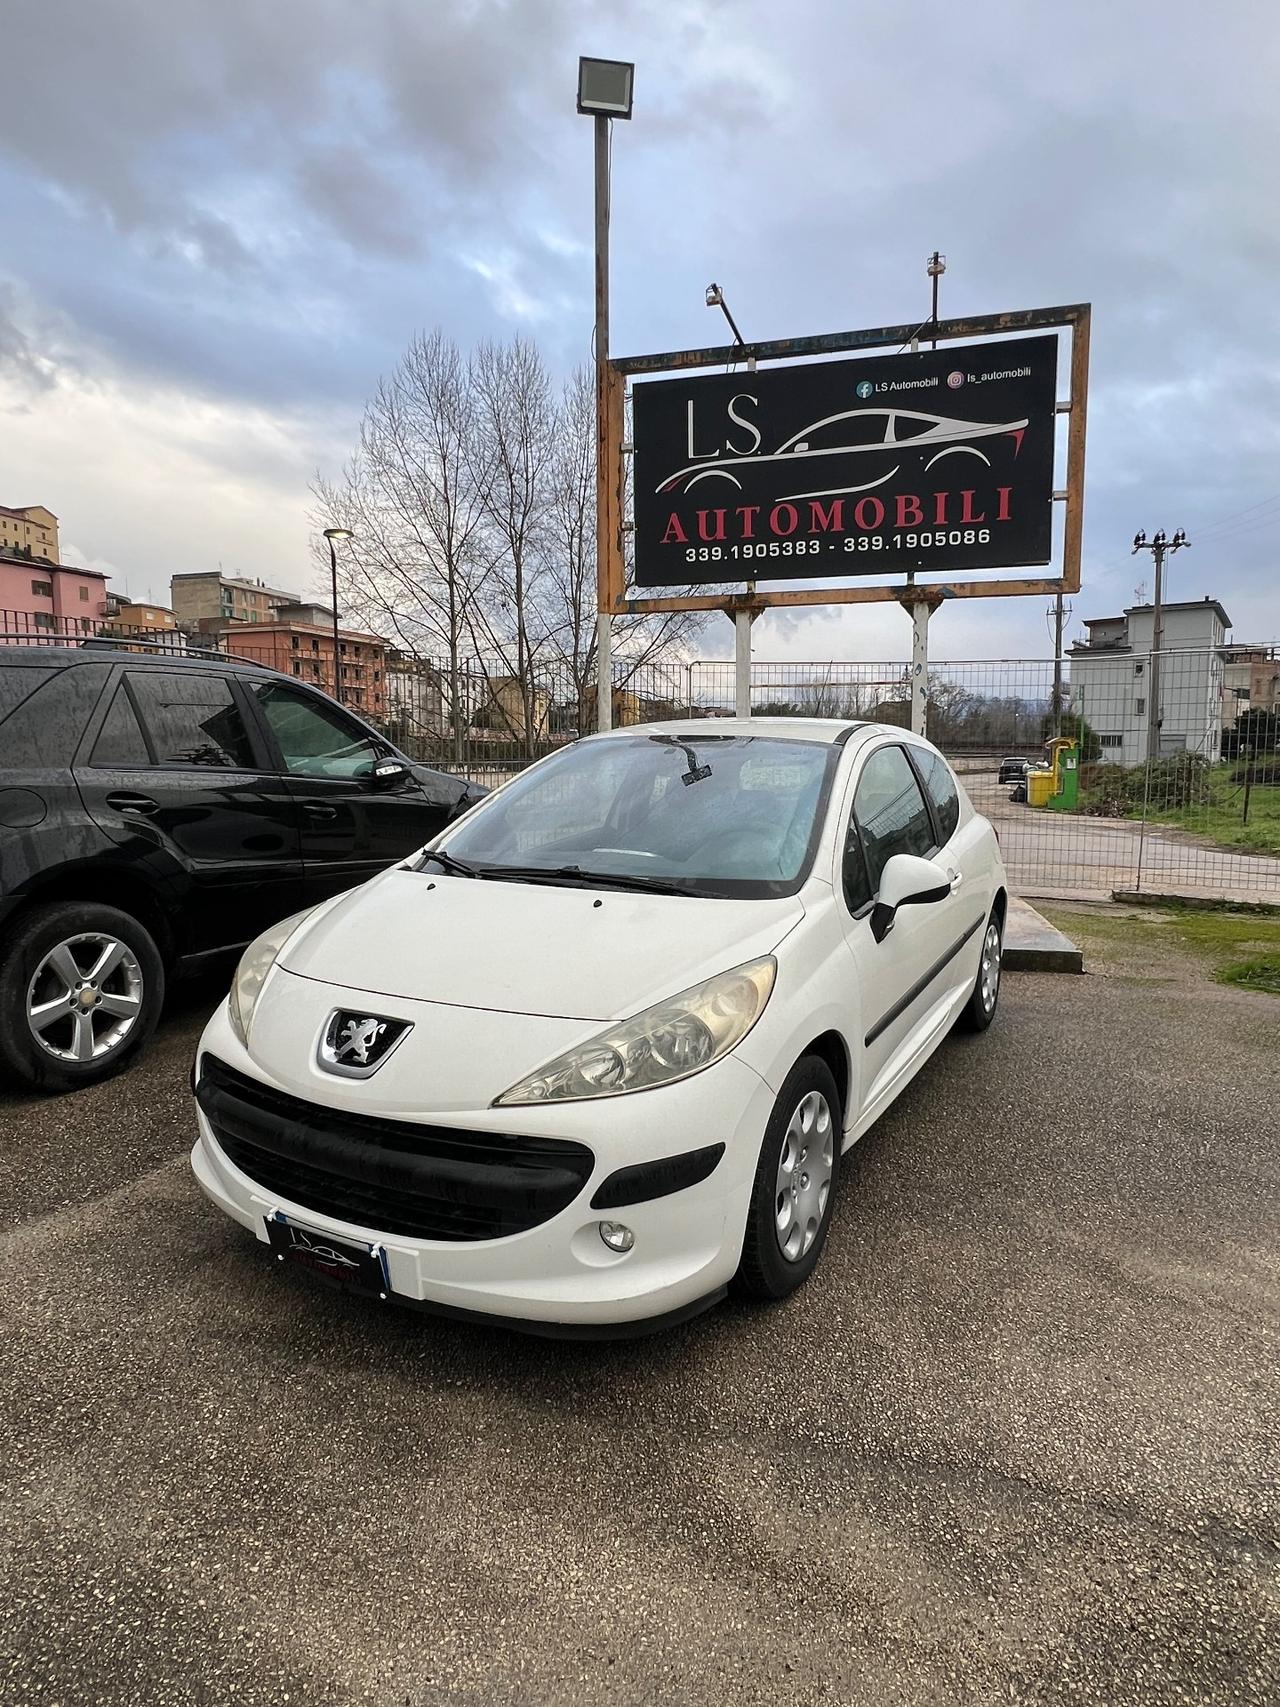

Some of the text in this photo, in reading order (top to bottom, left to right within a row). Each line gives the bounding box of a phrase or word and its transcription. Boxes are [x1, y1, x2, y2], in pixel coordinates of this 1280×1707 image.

[875, 377, 939, 392] LS Automobili
[967, 367, 1032, 385] ls_automobili
[659, 487, 1013, 544] AUTOMOBILI
[685, 540, 820, 562] 339.1905383
[843, 529, 991, 552] 339.1905086
